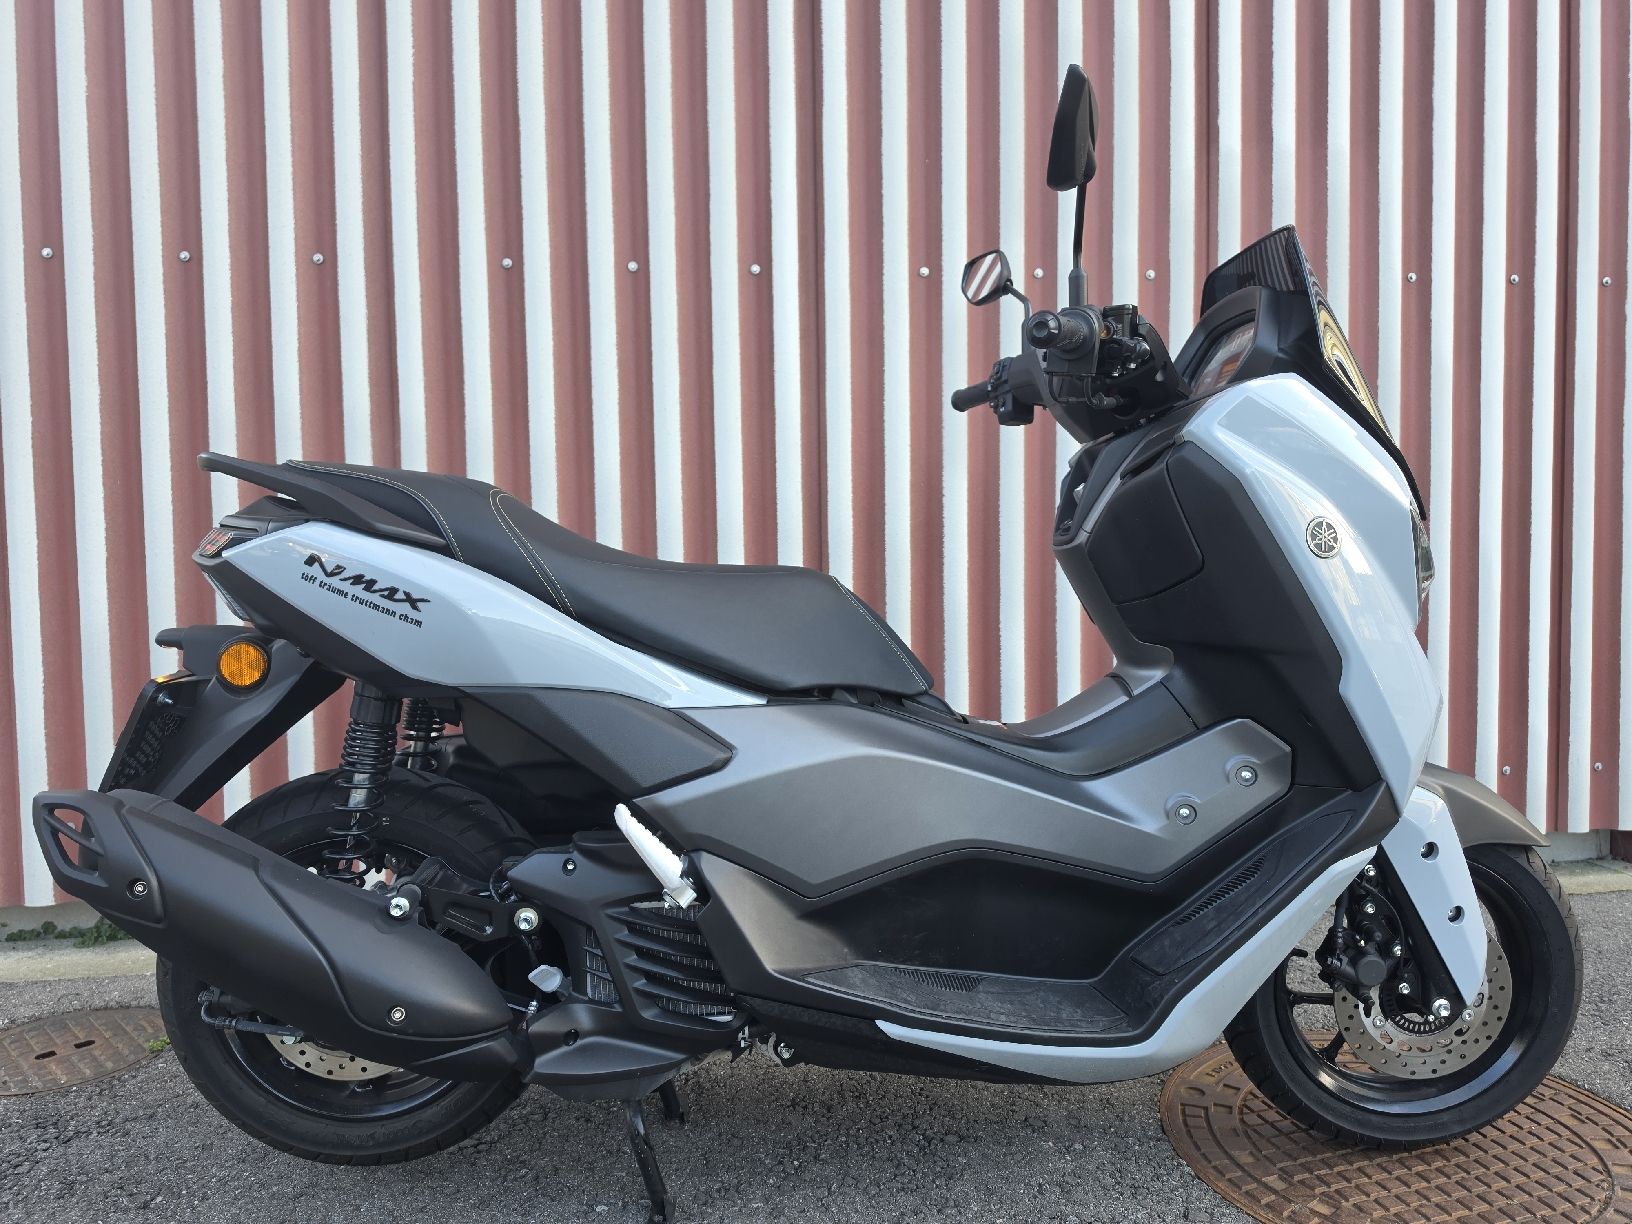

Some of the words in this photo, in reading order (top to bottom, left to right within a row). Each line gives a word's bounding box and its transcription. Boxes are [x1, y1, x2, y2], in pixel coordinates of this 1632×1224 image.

[301, 571, 317, 584] töff
[318, 579, 349, 599] träume
[351, 594, 397, 618] truttmann
[398, 613, 423, 629] cham
[304, 553, 430, 612] NMAX
